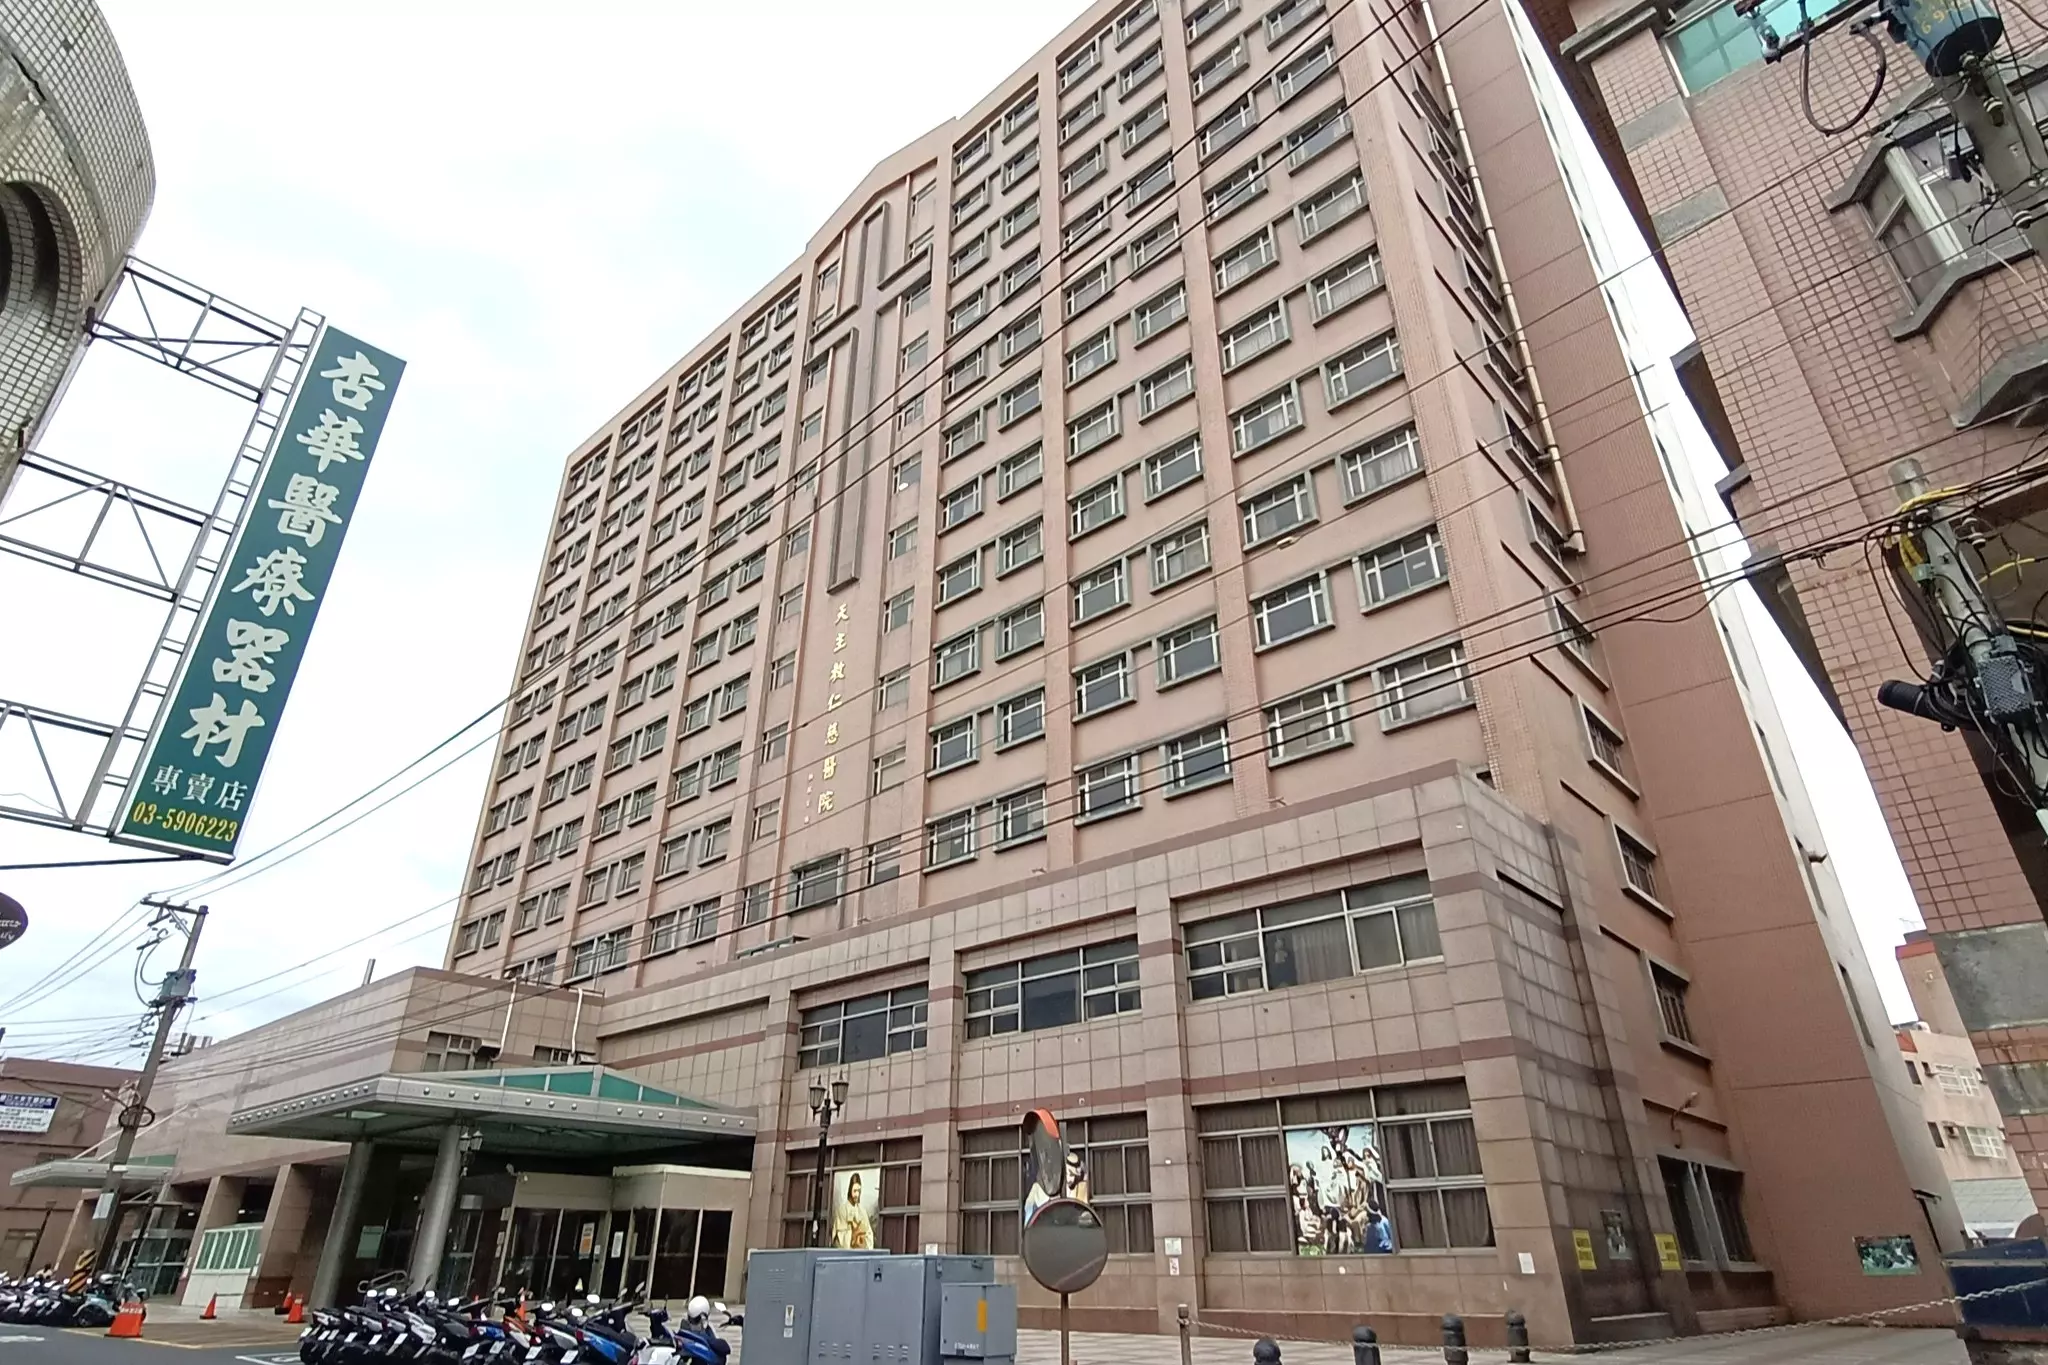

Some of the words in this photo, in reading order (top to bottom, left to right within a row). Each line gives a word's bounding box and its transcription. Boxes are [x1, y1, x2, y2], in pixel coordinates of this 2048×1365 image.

[181, 351, 385, 768] 杏華醫療器材
[817, 603, 849, 814] 天主教仁慈醫院
[133, 801, 238, 842] 03-5906223
[151, 765, 248, 811] 專賣店
